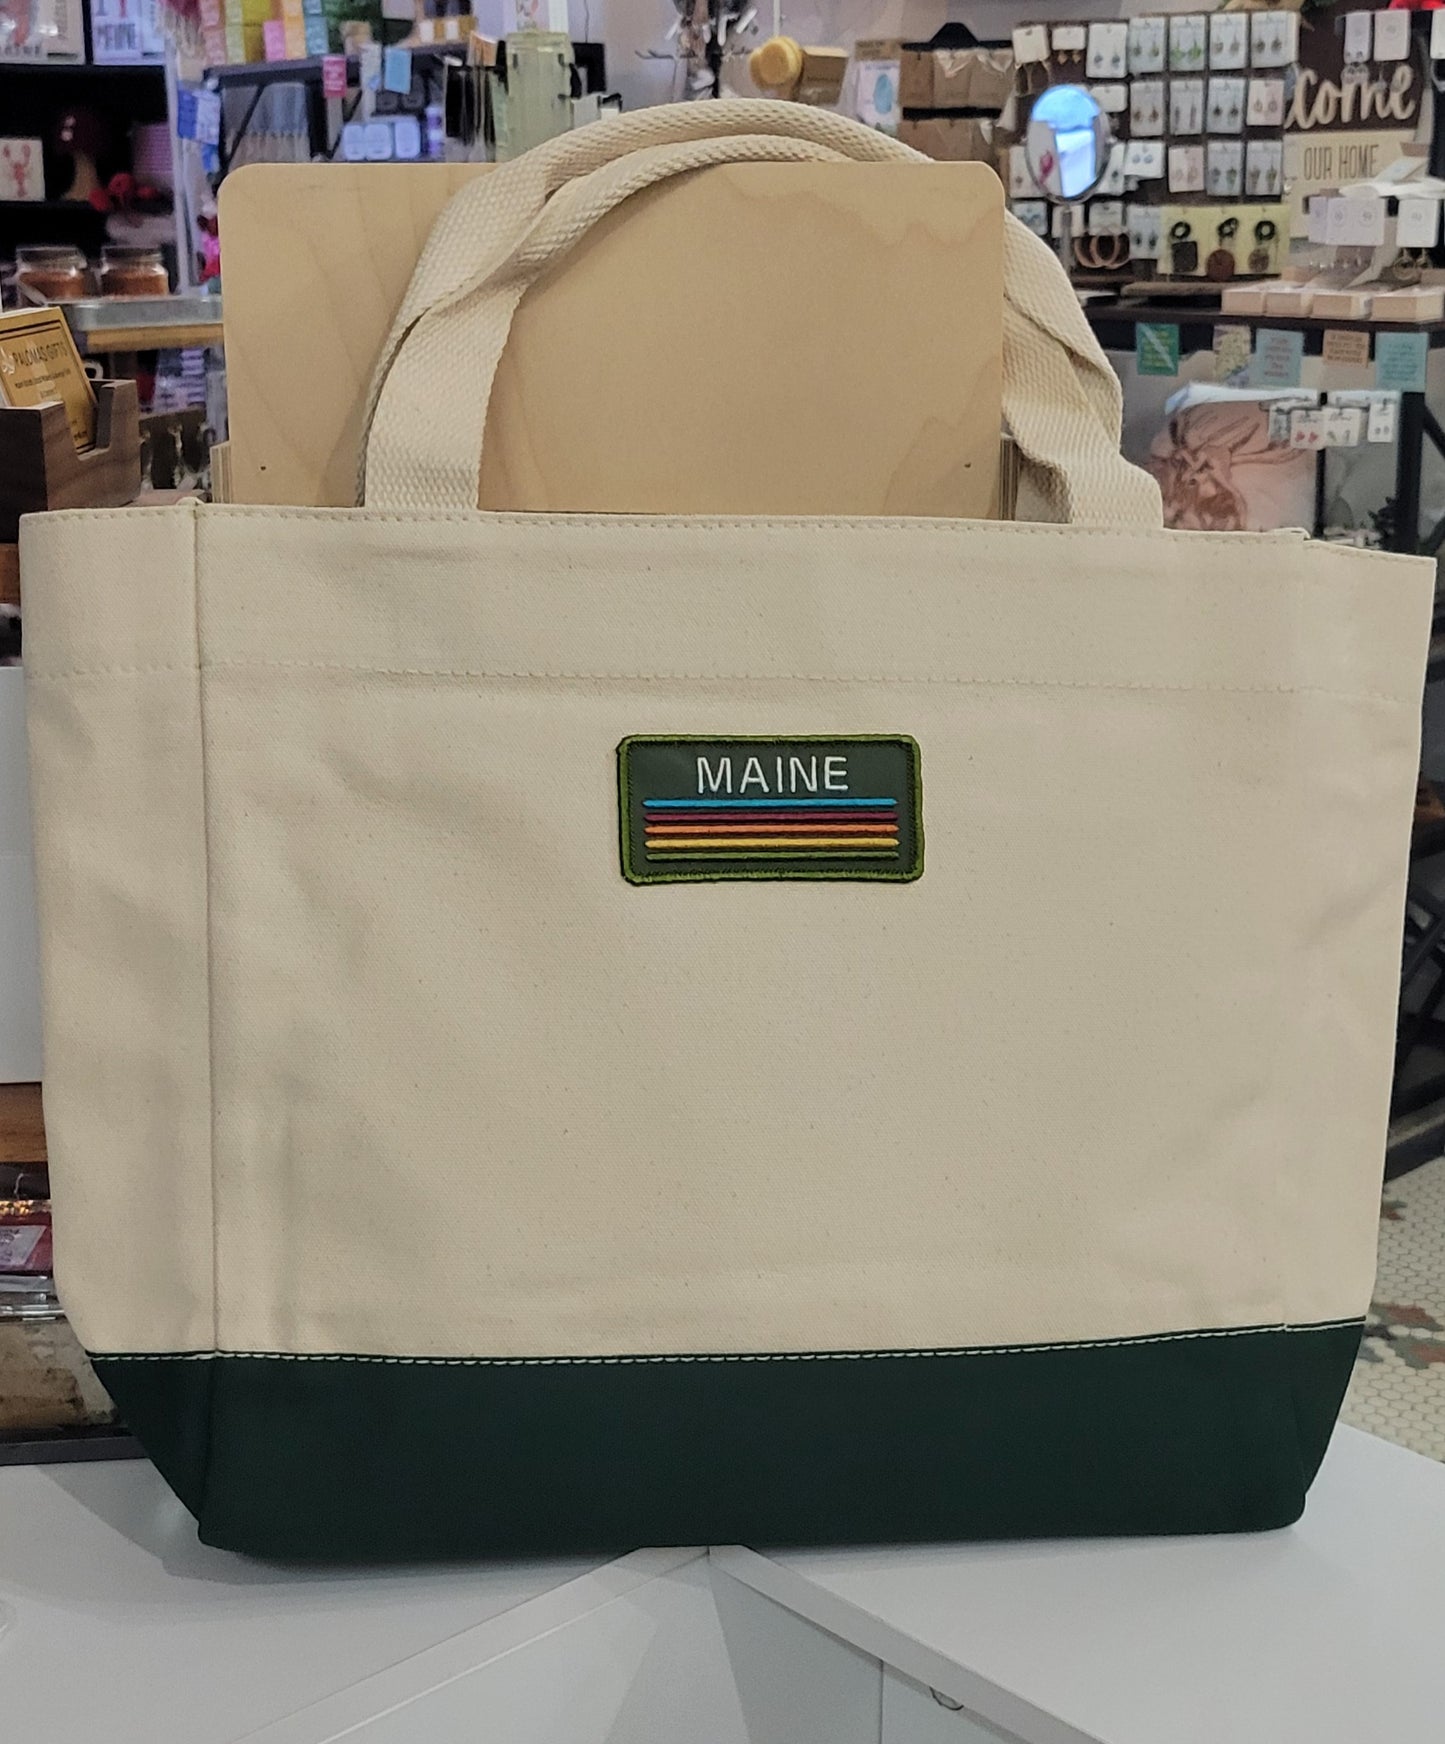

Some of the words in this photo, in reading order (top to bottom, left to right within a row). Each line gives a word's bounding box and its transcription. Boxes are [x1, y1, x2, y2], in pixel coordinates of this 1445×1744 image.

[1303, 147, 1333, 181] OUR
[1338, 144, 1380, 180] HOME
[697, 755, 849, 794] MAINE
